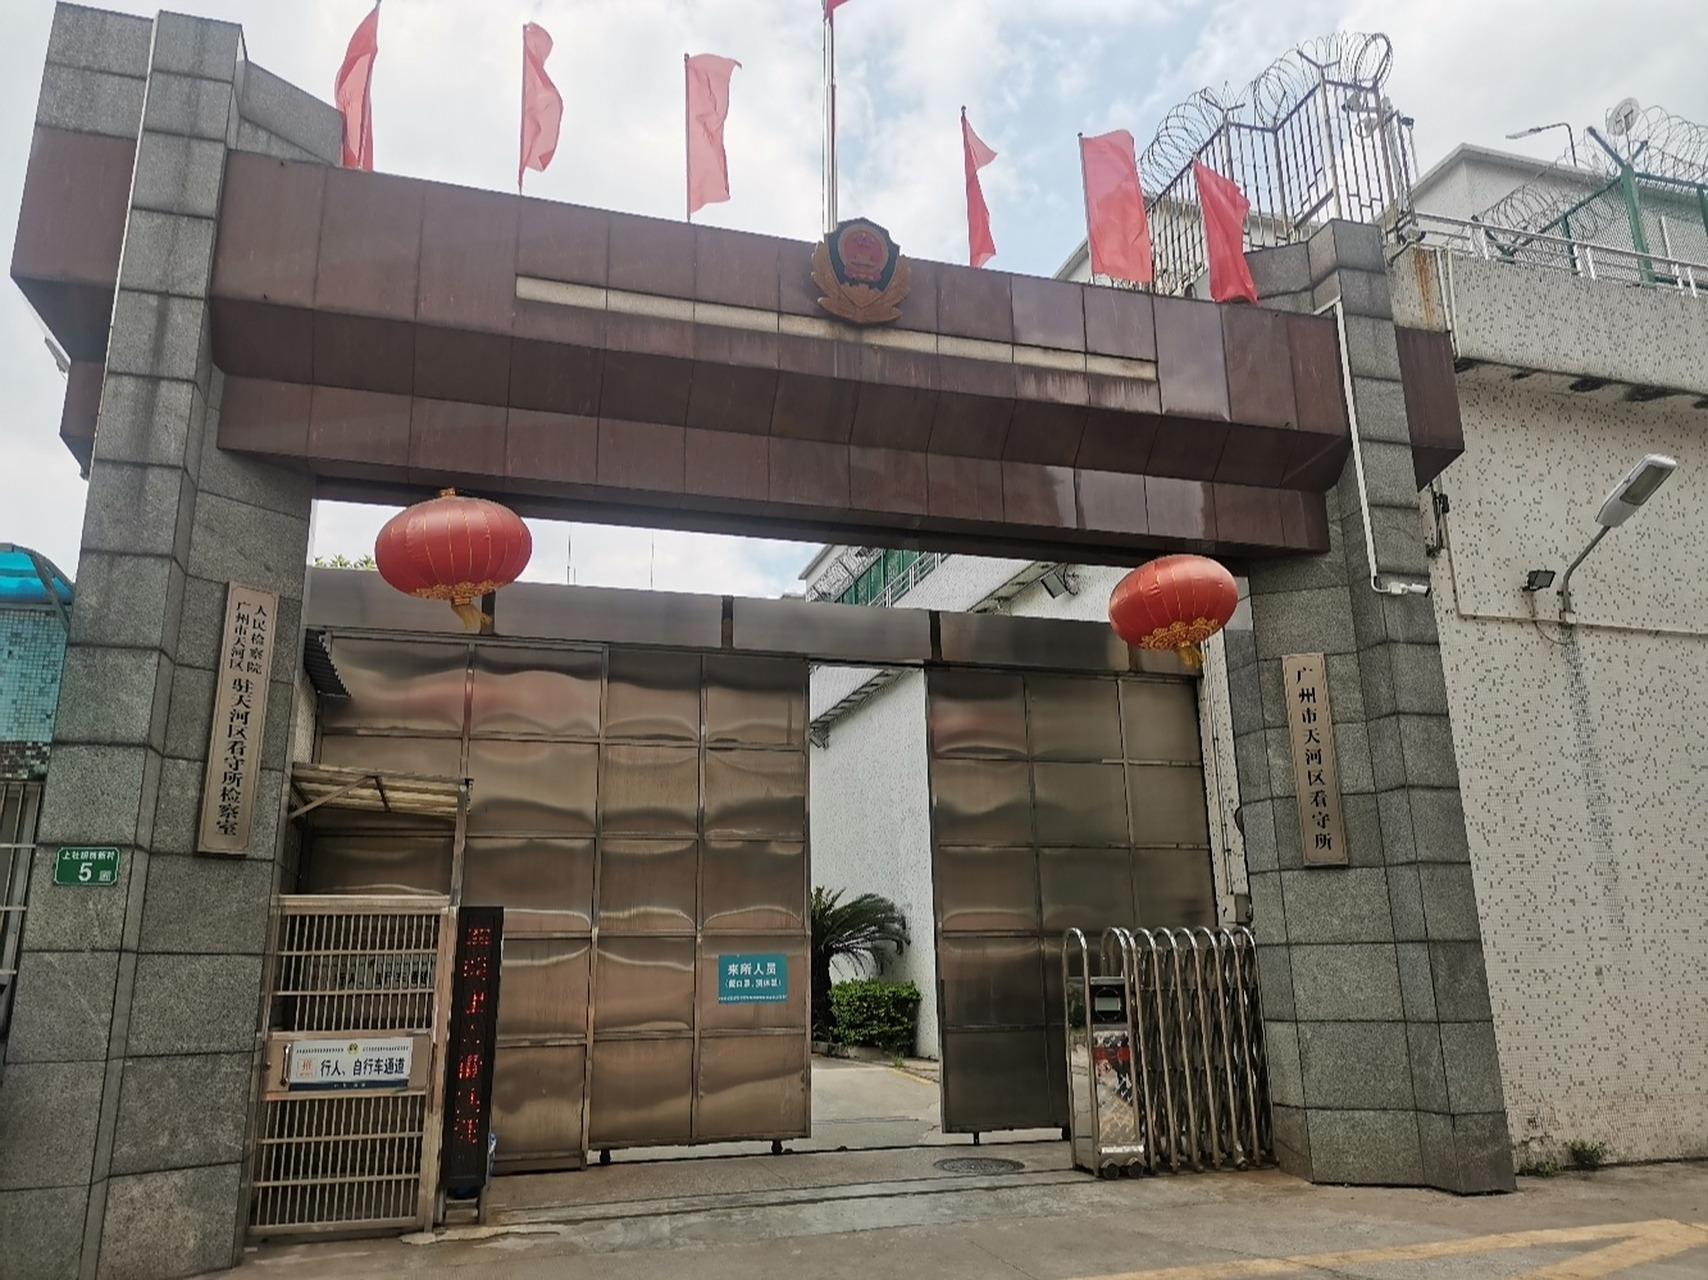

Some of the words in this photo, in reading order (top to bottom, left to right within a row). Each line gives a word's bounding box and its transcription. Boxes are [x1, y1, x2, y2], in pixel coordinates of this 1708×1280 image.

[246, 605, 268, 675] 人民检察院
[216, 677, 254, 836] 驻天河区看守所检察室
[1296, 666, 1333, 851] 广州市天河区看守所
[78, 862, 93, 882] 5
[727, 962, 777, 976] 来所人员
